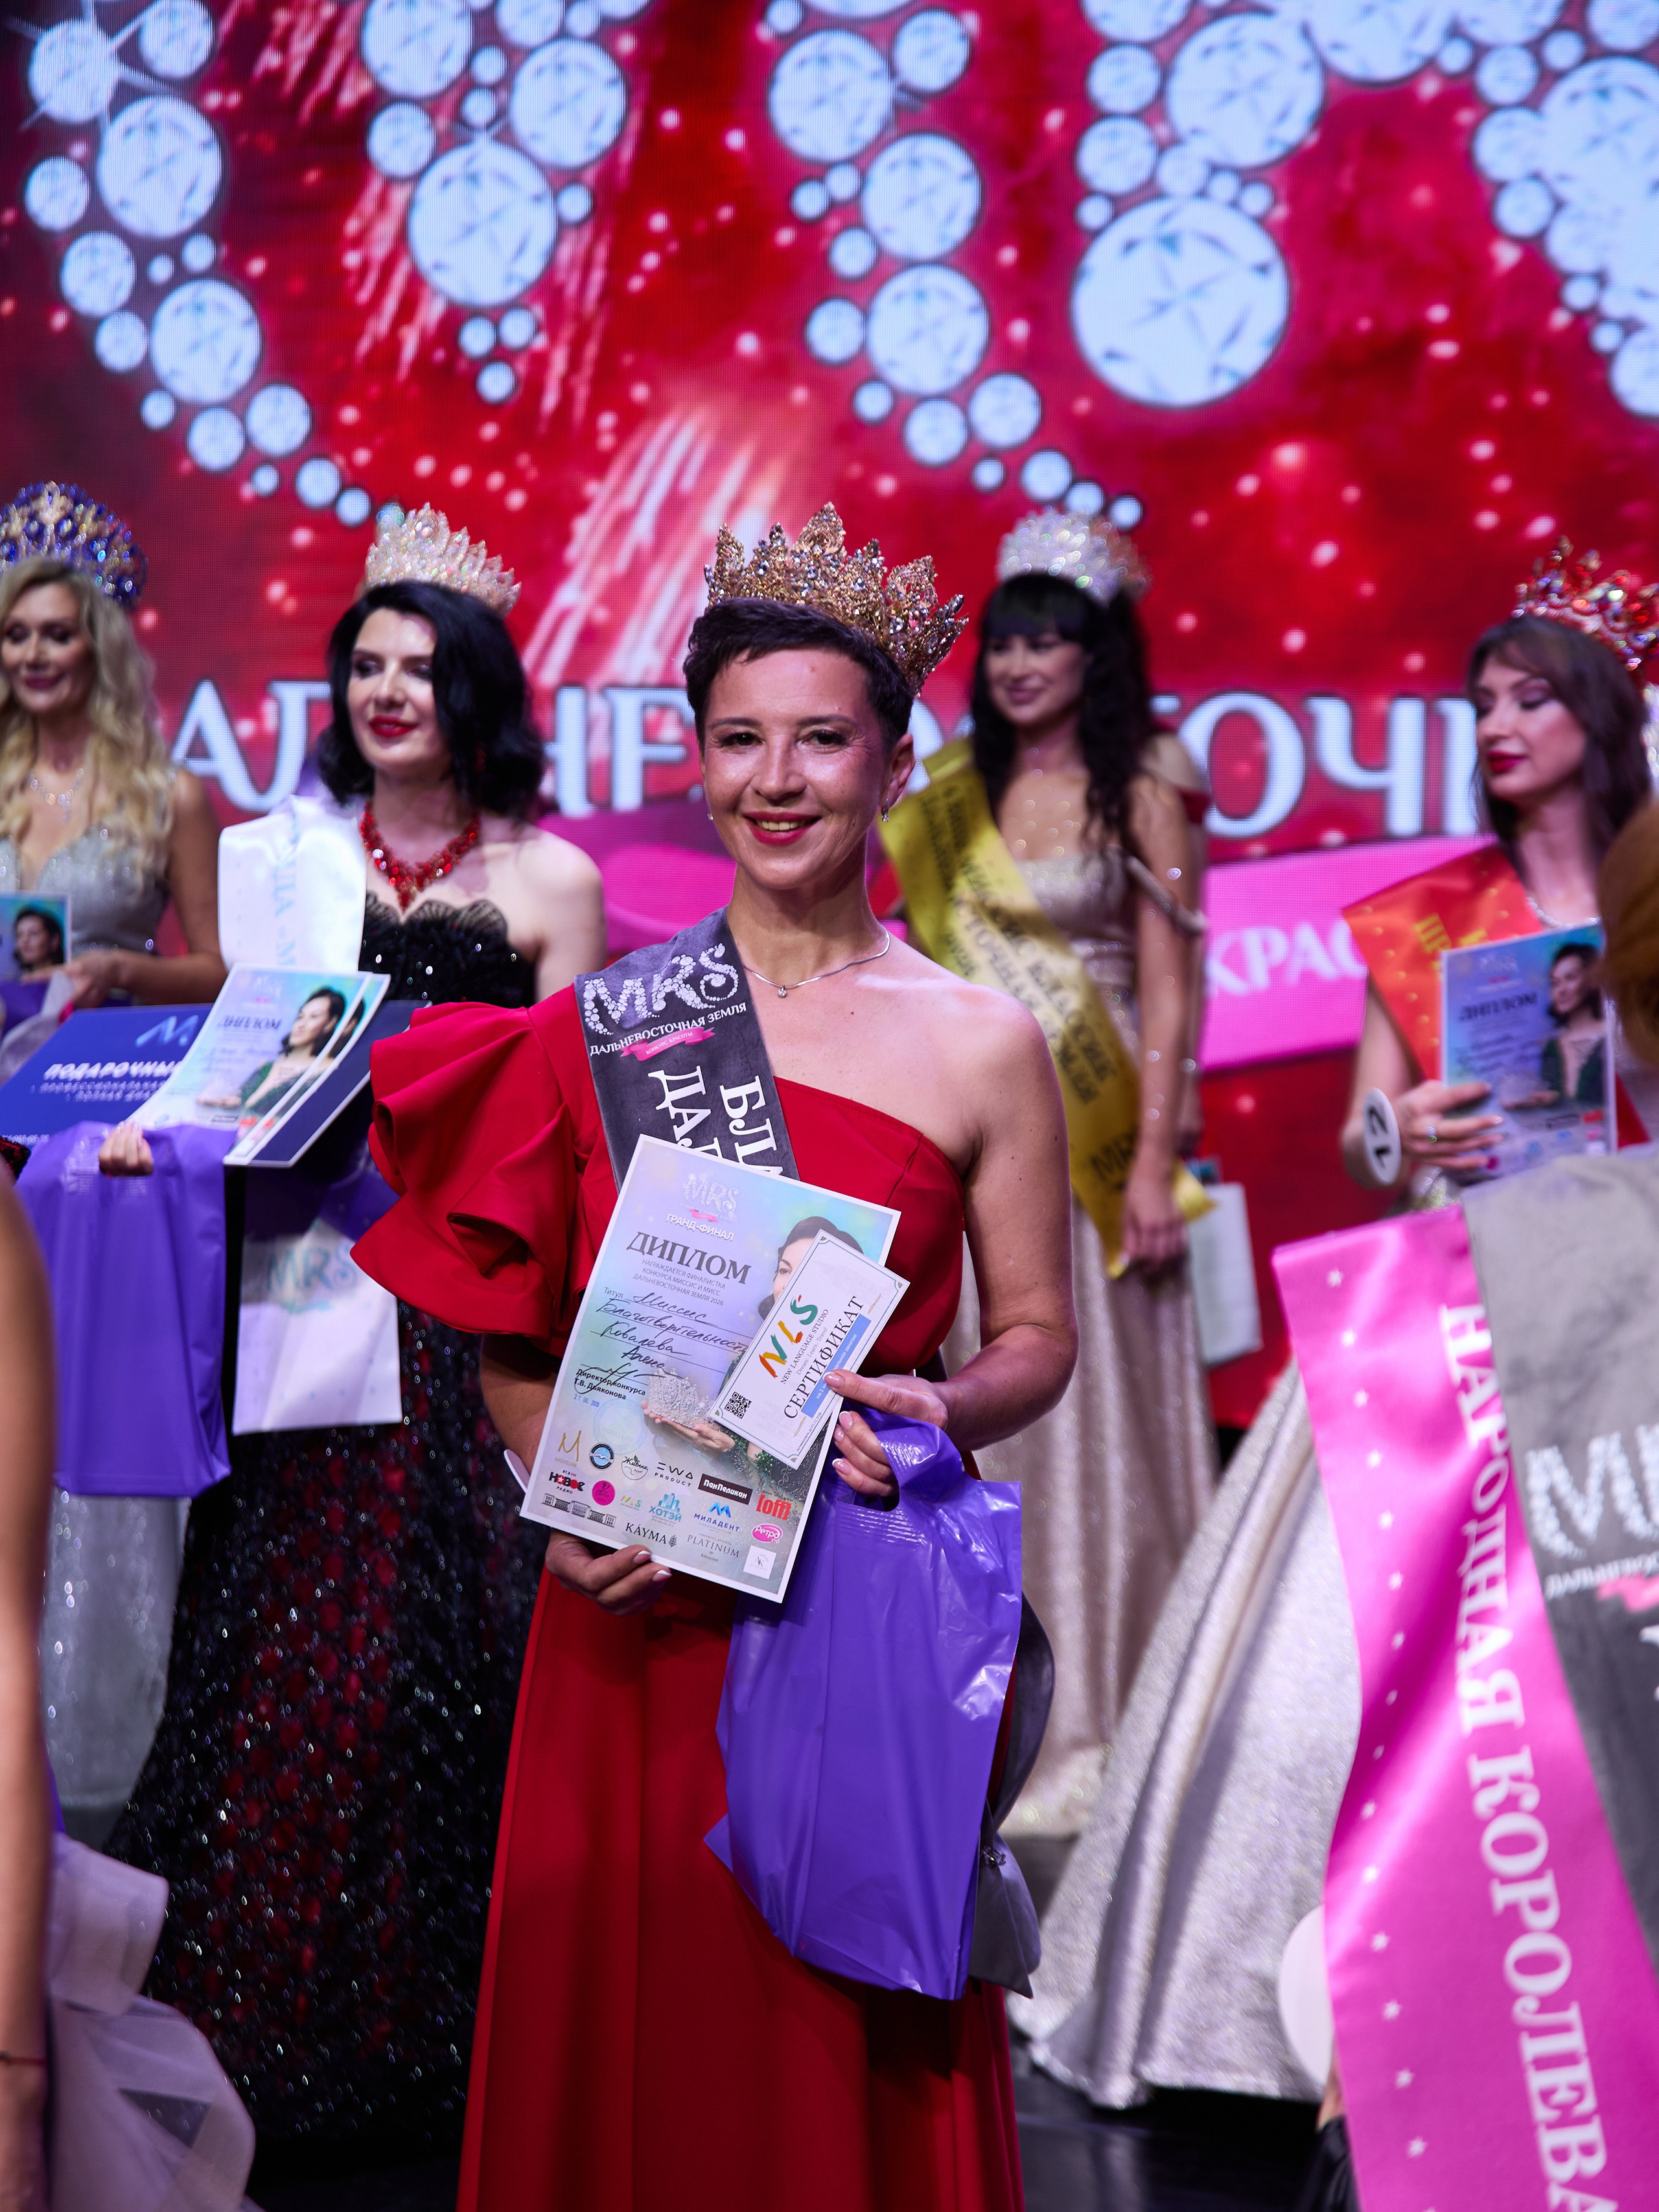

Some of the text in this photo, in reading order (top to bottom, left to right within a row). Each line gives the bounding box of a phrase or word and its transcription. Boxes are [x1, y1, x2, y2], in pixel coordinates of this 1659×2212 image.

[584, 942, 739, 1036] MRS
[590, 1002, 747, 1056] ДАЛЬНЕВОСТОЧНАЯ ЗЕМЛЯ
[645, 1030, 693, 1055] КОНКУРС КРАСОТЫ
[684, 1175, 739, 1215] MRS
[666, 1213, 734, 1241] ГРАНД-ФИНАЛ
[627, 1231, 752, 1285] ДИПЛОМ
[642, 1259, 726, 1289] НАГРАЖДАЕТСЯ ФИНАЛИСТКА
[642, 1267, 672, 1281] КОНКУРСА
[672, 1276, 697, 1288] МИССИС
[702, 1286, 720, 1296] МИСС
[603, 1286, 624, 1299] Титул
[633, 1273, 724, 1305] ДАЛЬНЕВОСТОЧНАЯ ЗЕМЛЯ 2026
[759, 1295, 818, 1378] NLS
[780, 1309, 830, 1384] NEW LANGUAGE STUDIO
[844, 1333, 858, 1352] занятие
[783, 1296, 863, 1419] СЕРТИФИКАТ
[796, 1327, 828, 1375] Dream Learn Travel
[573, 1378, 587, 1387] Т.В.
[586, 1382, 627, 1400] Дьяконова
[576, 1369, 612, 1386] Директор
[612, 1380, 646, 1396] конкурса
[556, 1486, 573, 1495] РАДИО
[655, 1472, 691, 1487] PRODUCT
[703, 1478, 748, 1499] ПанПеликан
[649, 1506, 682, 1522] ХОТЭЙ
[693, 1513, 739, 1533] МИЛАДЕНТ
[687, 1534, 740, 1557] PLATINUM
[755, 1525, 781, 1539] Ретро
